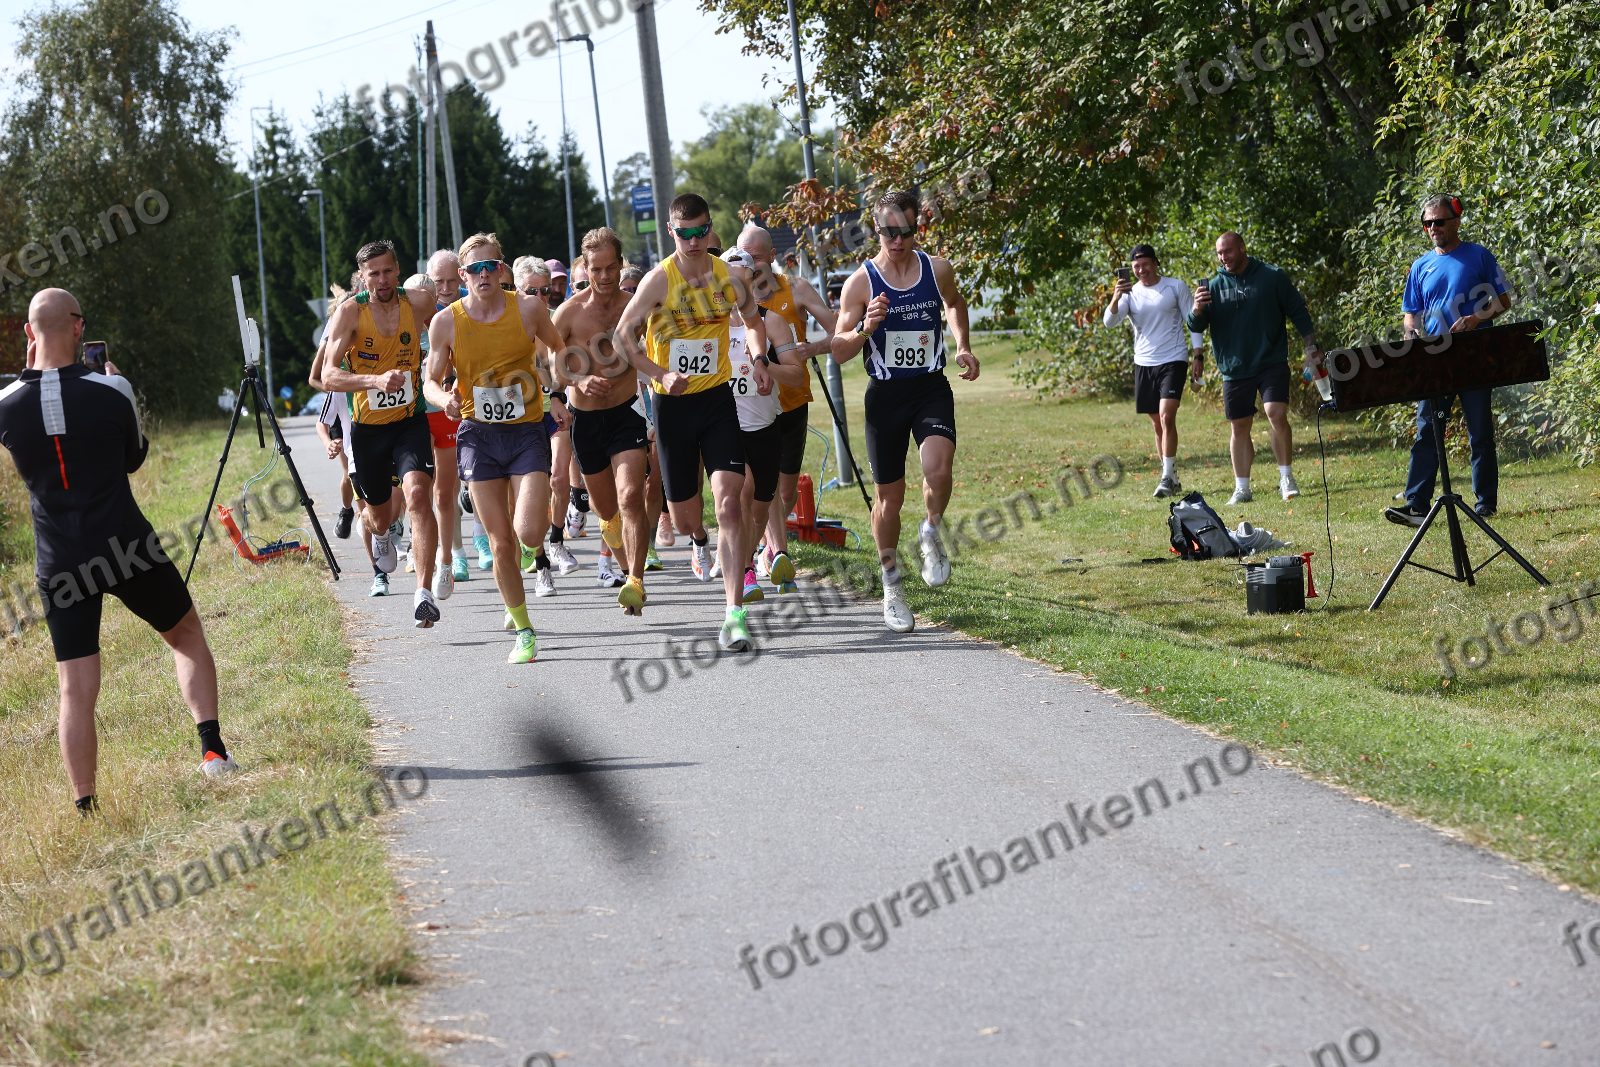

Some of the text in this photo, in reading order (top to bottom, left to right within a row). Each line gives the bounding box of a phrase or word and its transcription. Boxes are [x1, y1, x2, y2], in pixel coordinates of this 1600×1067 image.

[886, 300, 938, 314] PAREBANKEN
[902, 313, 919, 321] SØR
[678, 355, 711, 374] 942
[894, 348, 926, 367] 993
[376, 388, 407, 408] 252
[482, 401, 516, 421] 992
